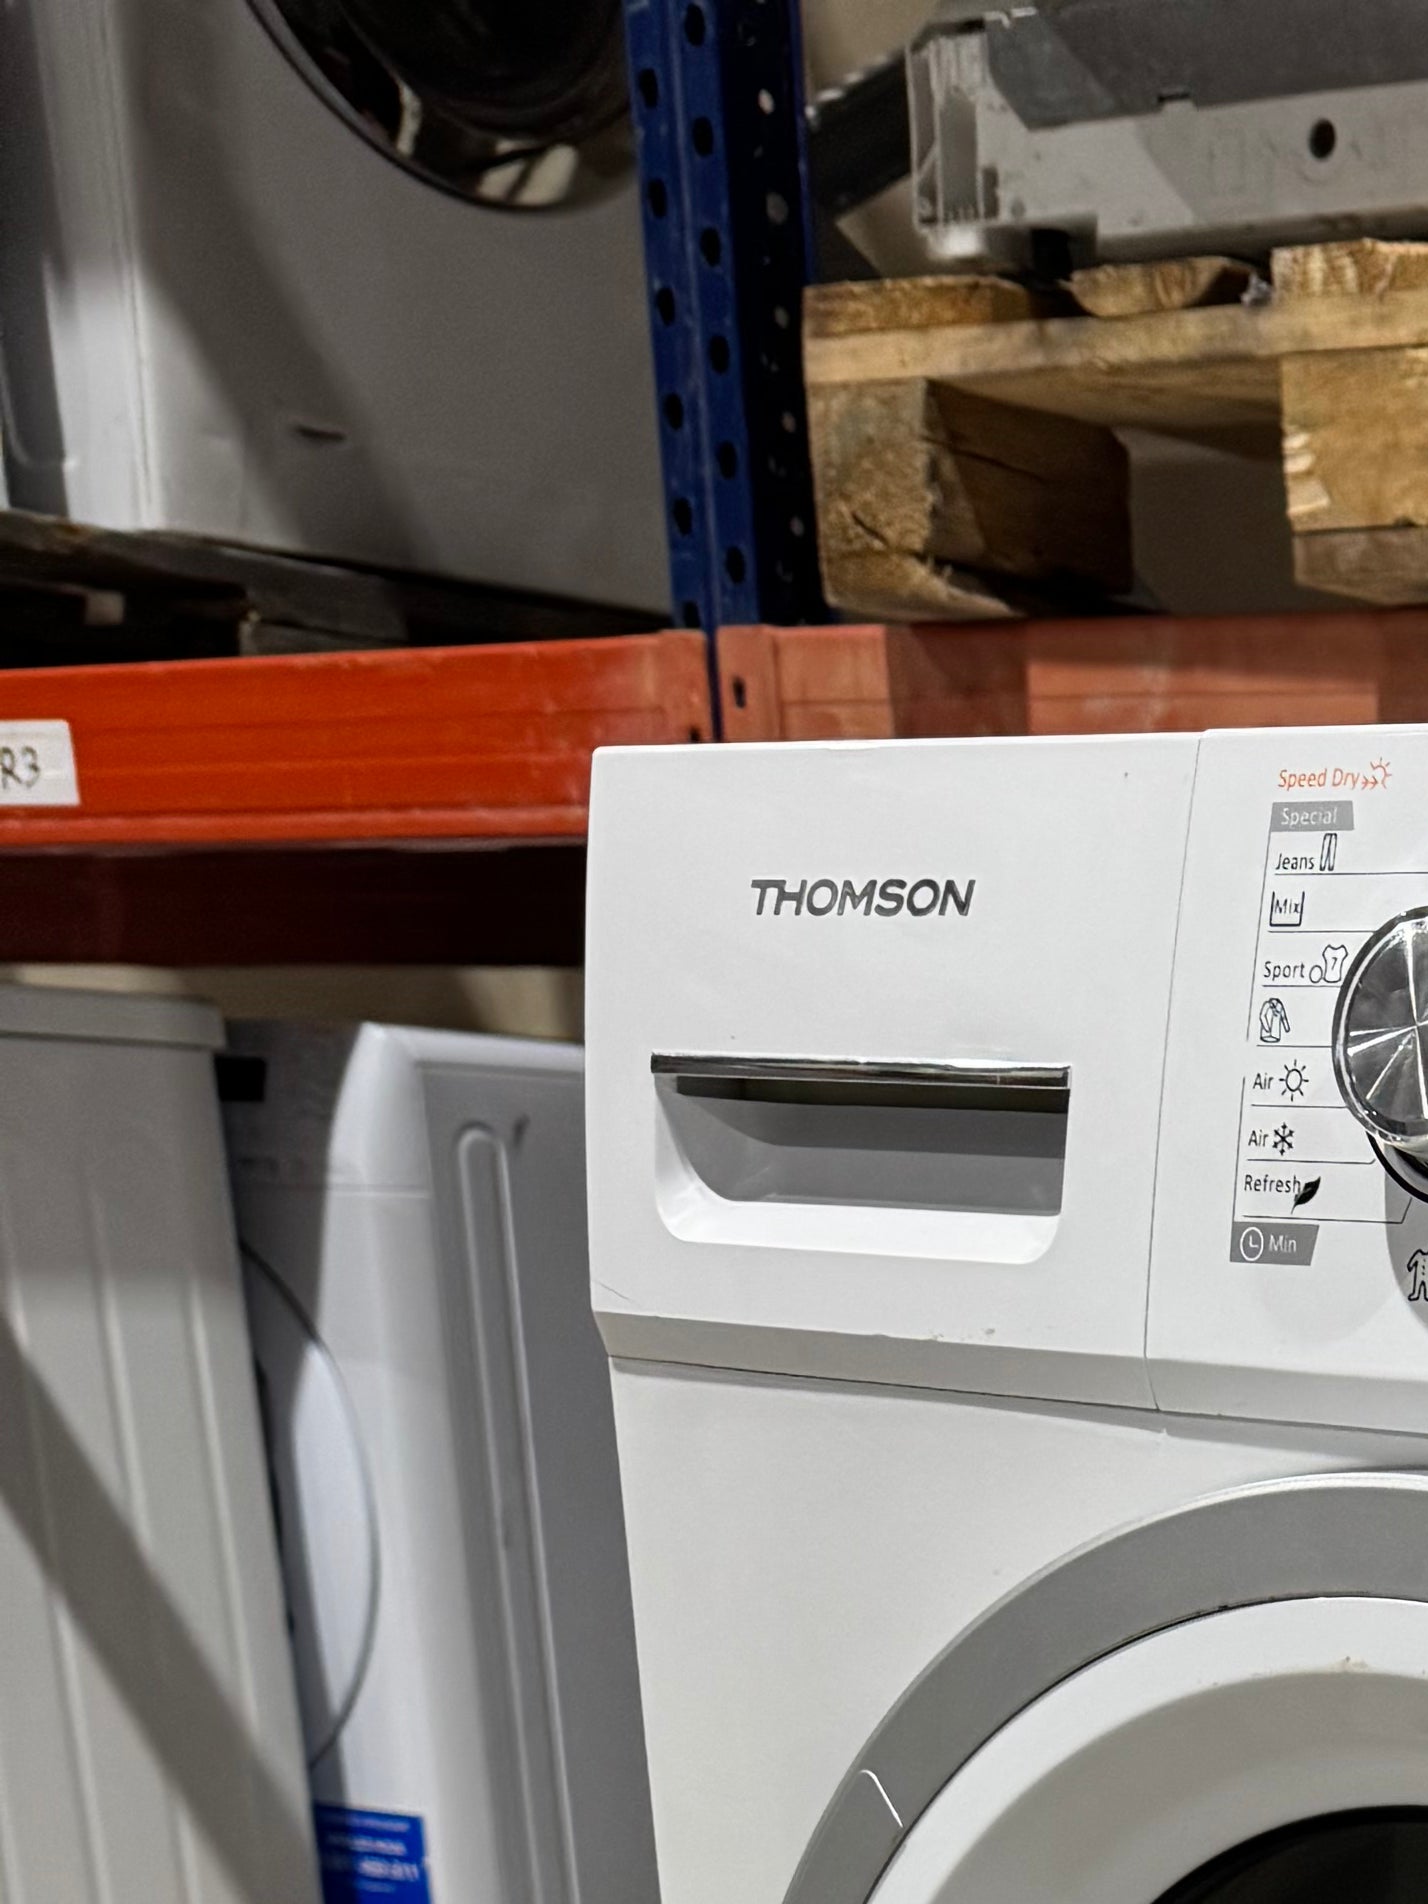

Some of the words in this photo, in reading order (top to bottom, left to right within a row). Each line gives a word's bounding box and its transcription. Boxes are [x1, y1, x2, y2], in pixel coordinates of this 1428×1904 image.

[1278, 768, 1328, 791] Speed
[1331, 768, 1360, 790] Dry
[1280, 807, 1338, 829] Special
[1275, 853, 1315, 870] Jeans
[751, 878, 977, 917] THOMSON
[1273, 898, 1301, 914] Mix
[1263, 961, 1305, 981] Sport
[1252, 1073, 1274, 1090] Air
[1248, 1130, 1269, 1147] Air
[1244, 1174, 1301, 1194] Refresh
[1268, 1235, 1298, 1254] Min
